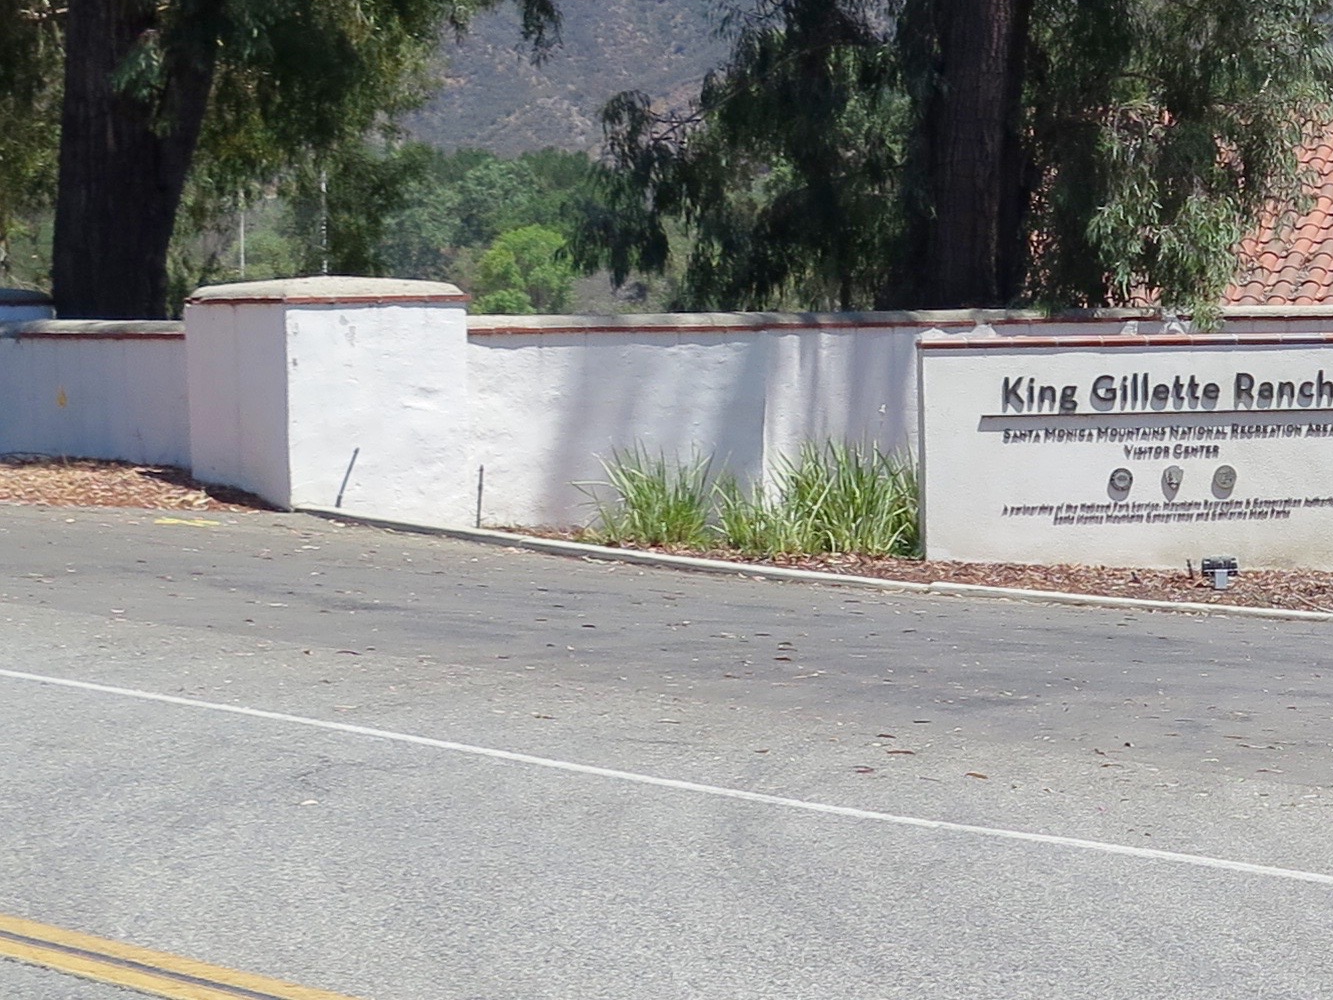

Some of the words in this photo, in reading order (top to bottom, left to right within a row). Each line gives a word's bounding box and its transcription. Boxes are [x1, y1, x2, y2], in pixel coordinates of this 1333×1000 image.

[1001, 375, 1078, 411] King
[1091, 372, 1220, 407] Gillette
[1003, 427, 1041, 442] SANTA
[1044, 427, 1094, 441] MONICA
[1098, 426, 1167, 440] MOUNTAINS
[1169, 425, 1228, 439] NATIONAL
[1231, 423, 1302, 438] RECREATION
[1123, 444, 1170, 459] VISITOR
[1173, 443, 1220, 458] CENTER
